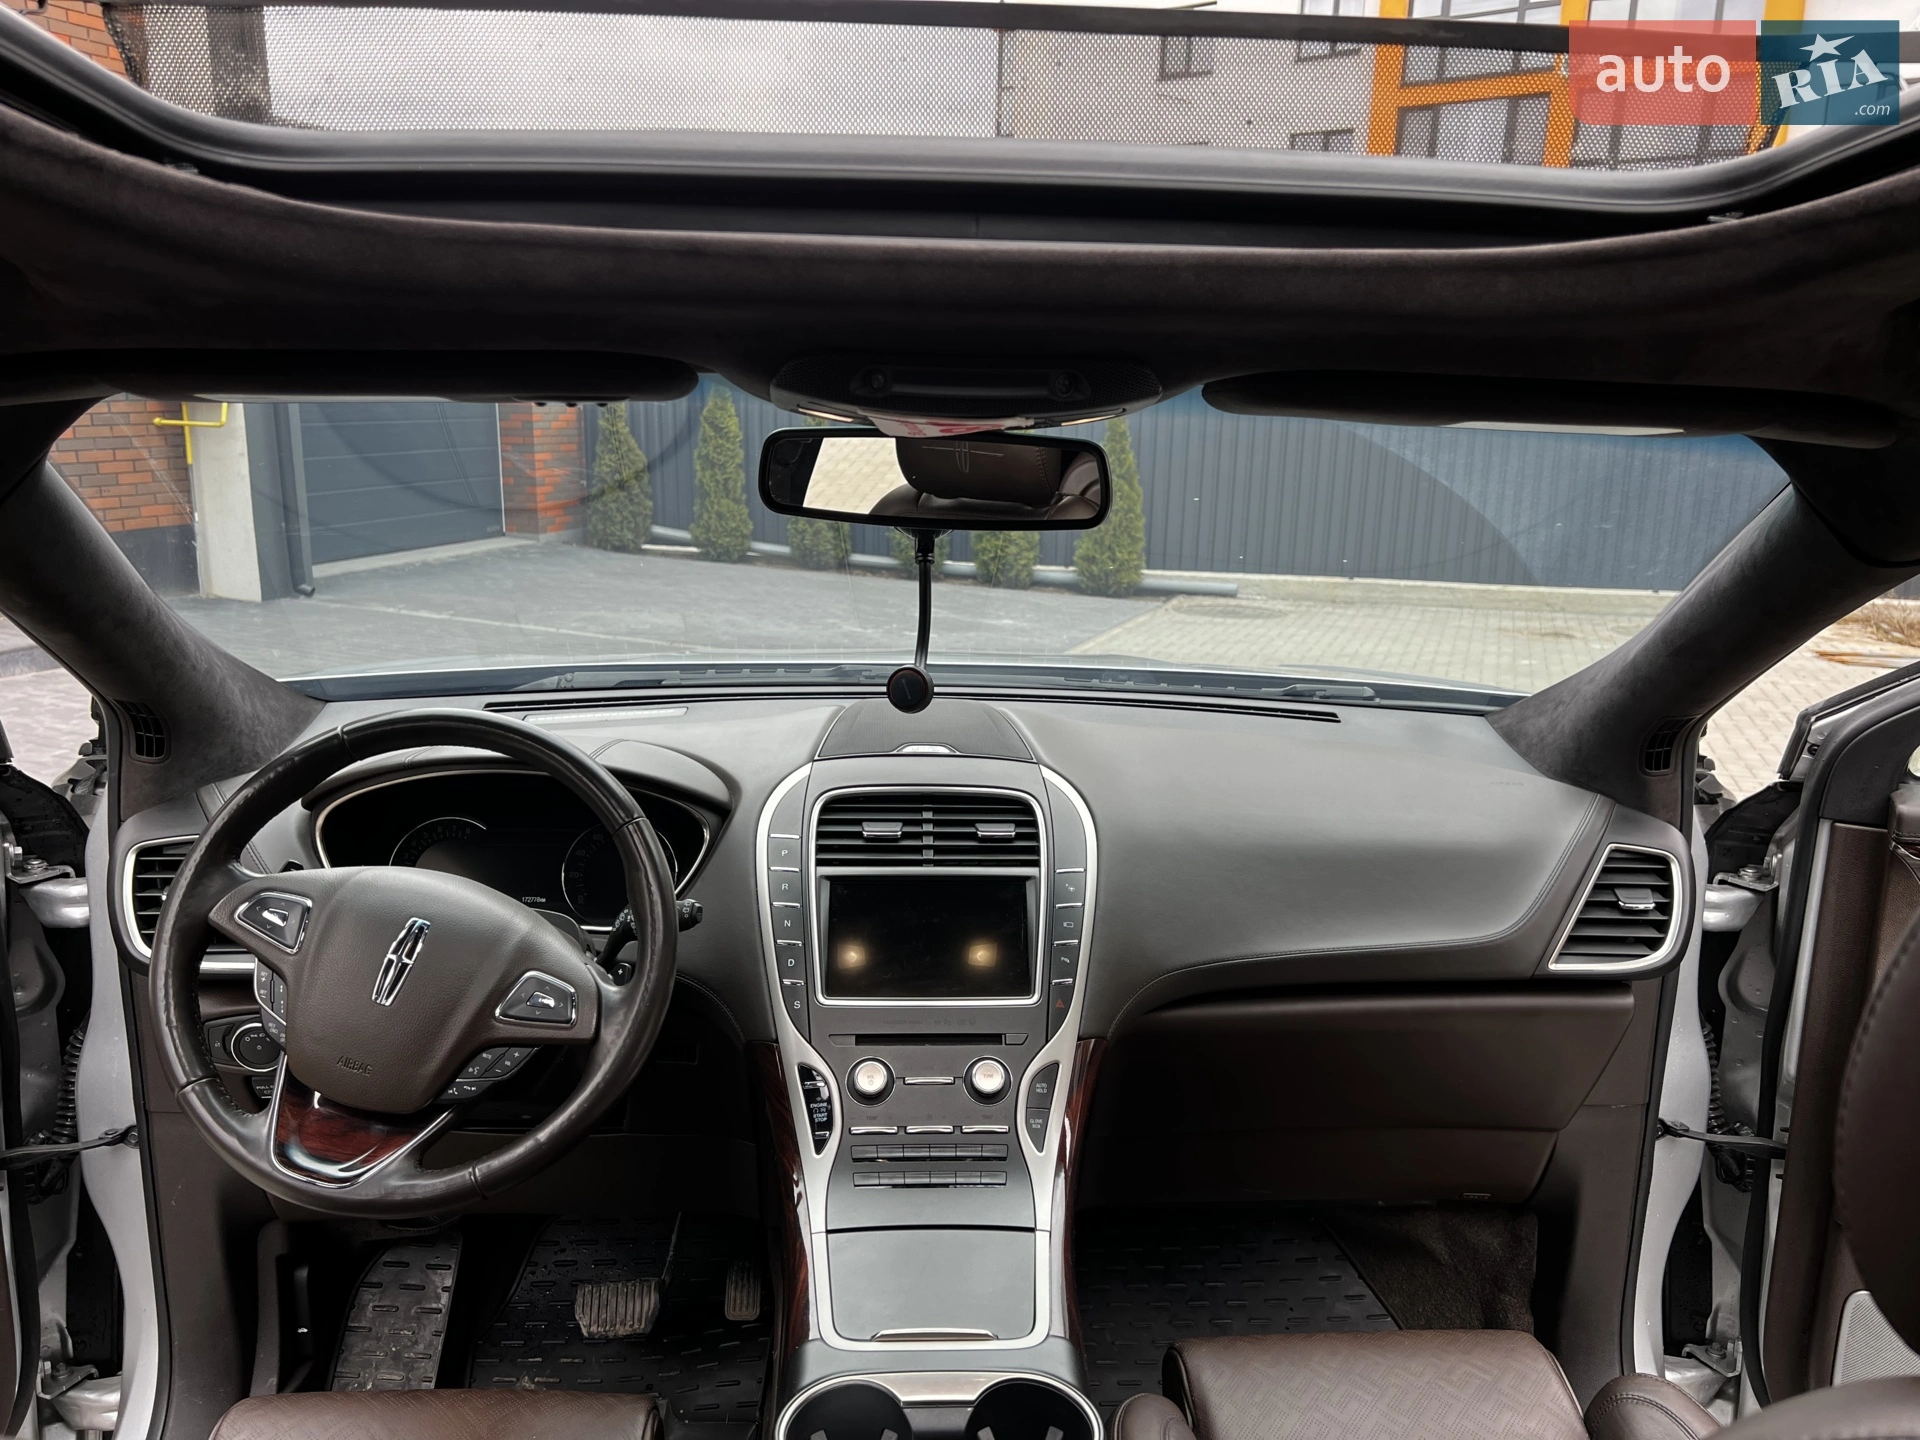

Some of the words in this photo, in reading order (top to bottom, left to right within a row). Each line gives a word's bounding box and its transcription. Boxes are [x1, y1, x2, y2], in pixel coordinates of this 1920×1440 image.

[787, 958, 795, 967] D
[793, 1000, 801, 1009] S
[336, 1055, 373, 1077] AIRBAG
